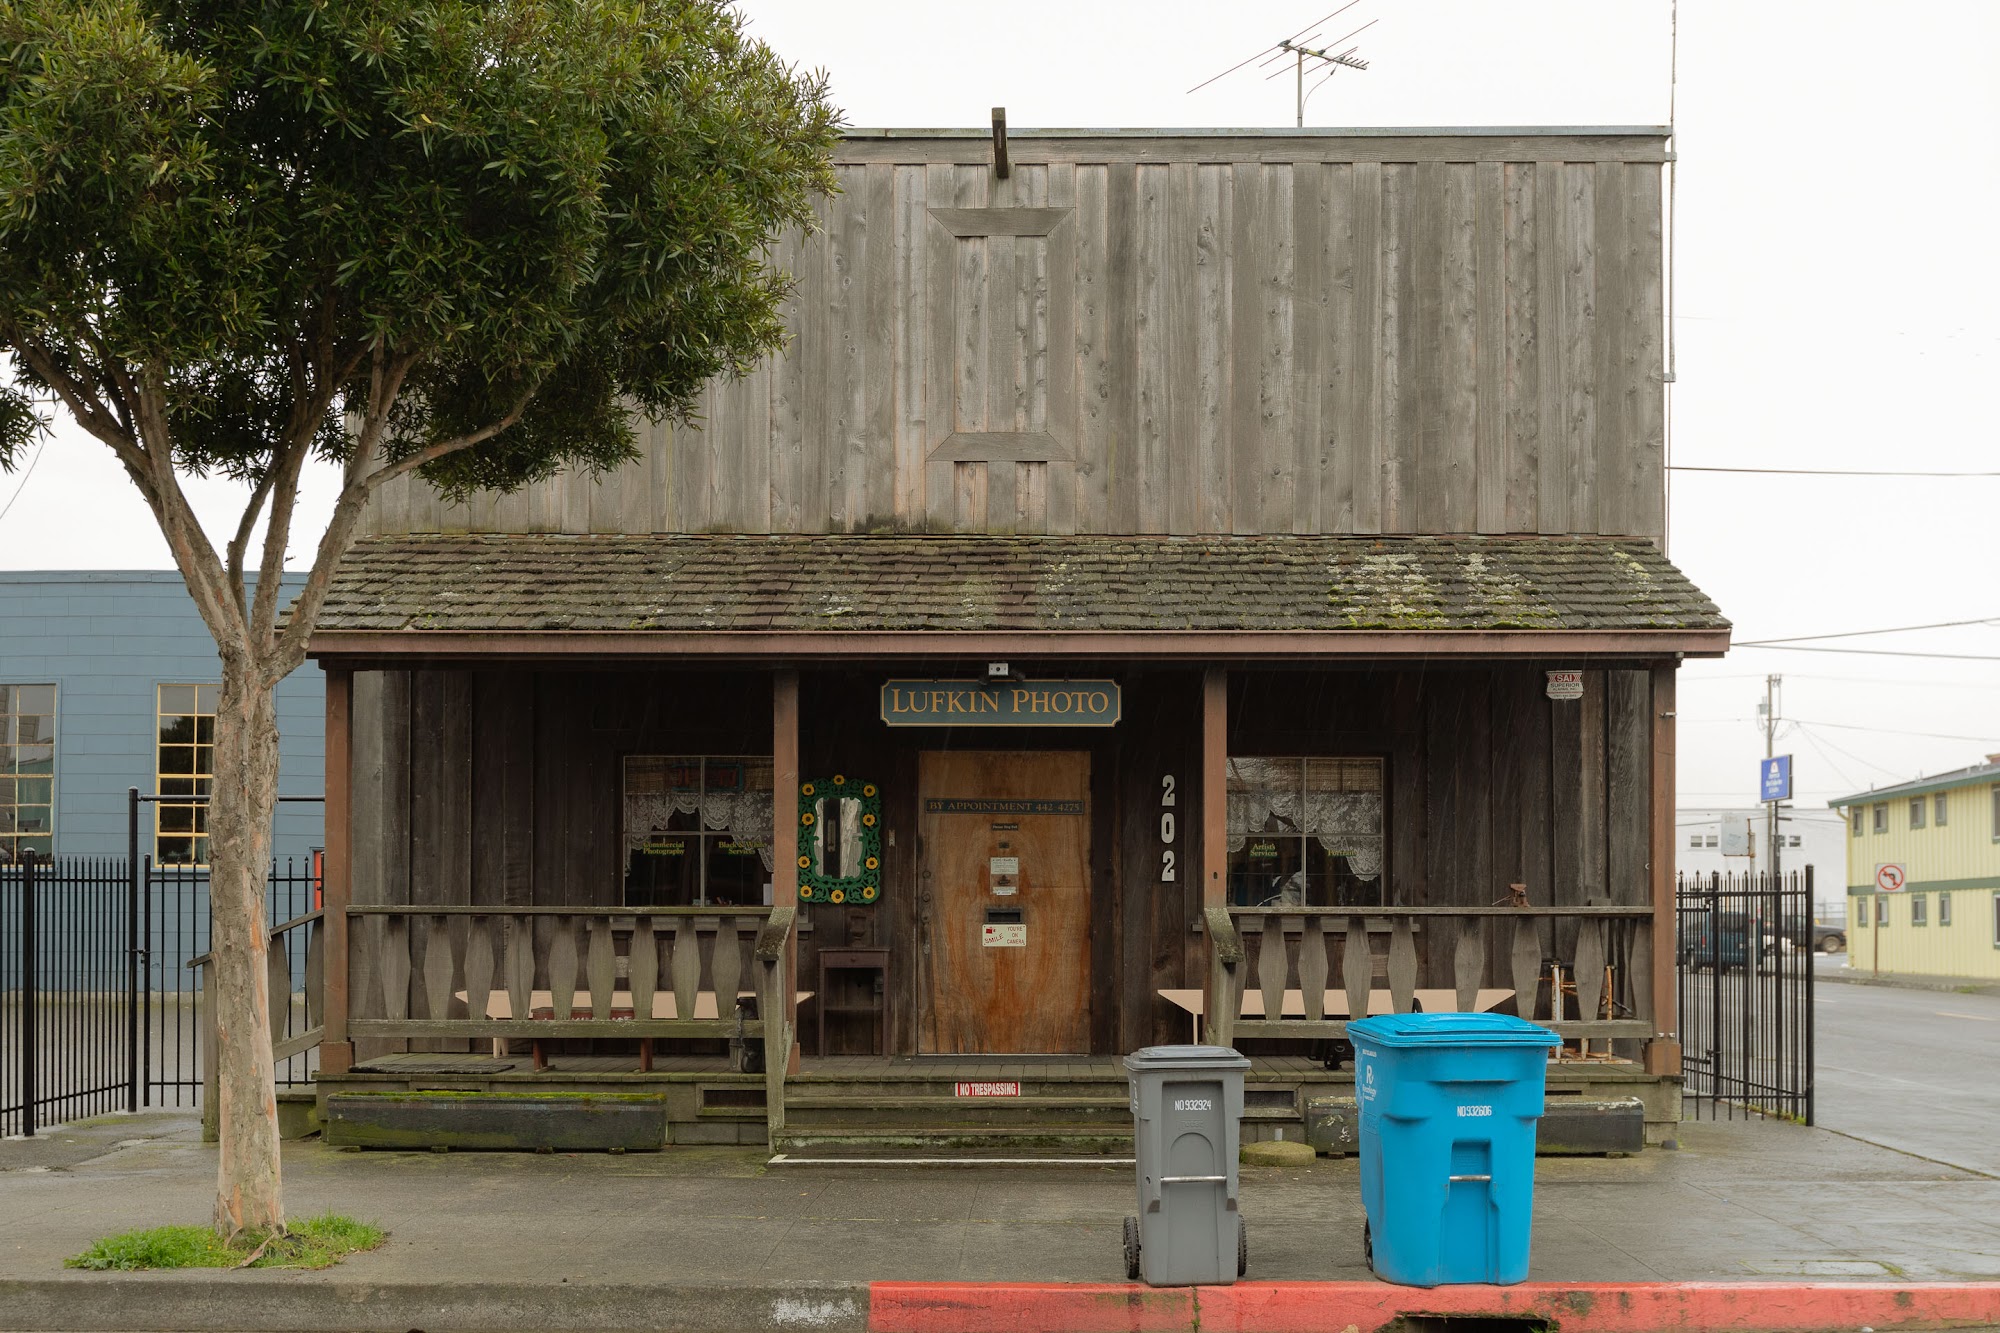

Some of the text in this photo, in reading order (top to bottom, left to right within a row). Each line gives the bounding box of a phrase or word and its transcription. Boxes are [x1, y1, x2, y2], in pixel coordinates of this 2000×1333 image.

[1557, 674, 1572, 682] SAI
[892, 688, 1109, 713] LUFKIN PHOTO
[930, 802, 943, 811] BY
[947, 802, 1033, 811] APPOINTMENT
[1161, 774, 1175, 882] 202
[643, 841, 684, 849] Commercial
[719, 841, 736, 849] Black
[985, 933, 1004, 943] SMILE
[960, 1083, 1016, 1096] NO TRESPASSING
